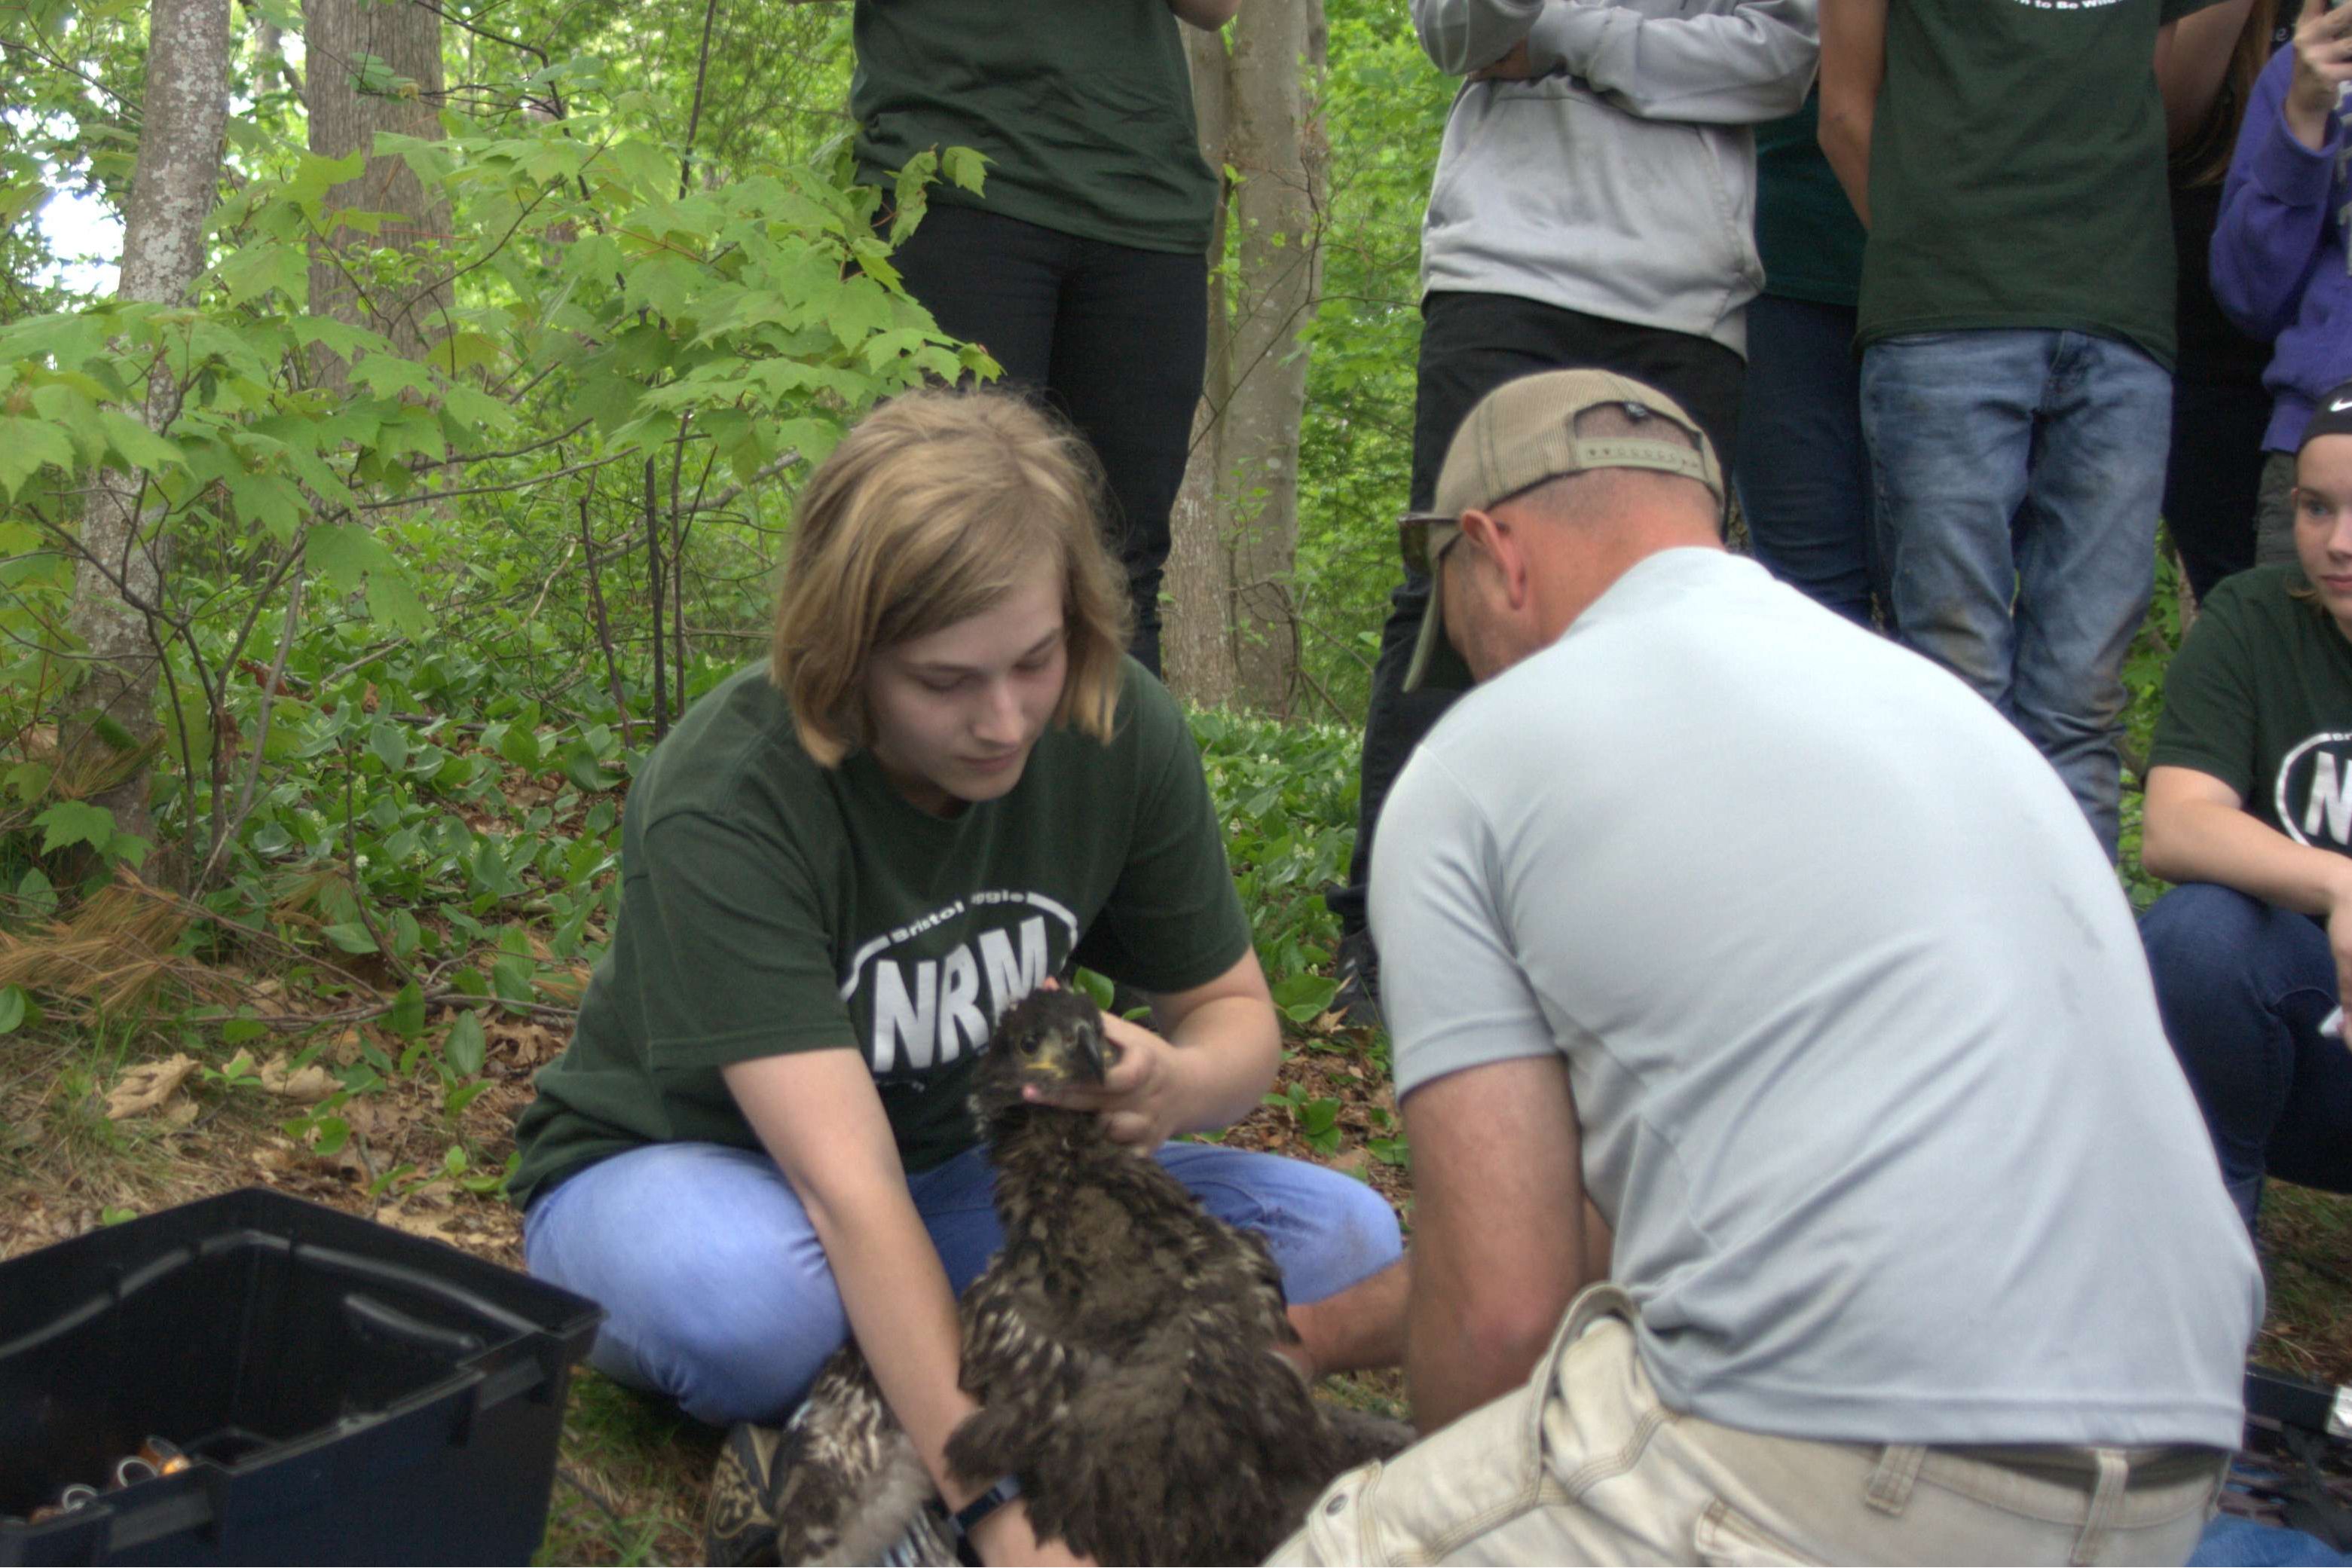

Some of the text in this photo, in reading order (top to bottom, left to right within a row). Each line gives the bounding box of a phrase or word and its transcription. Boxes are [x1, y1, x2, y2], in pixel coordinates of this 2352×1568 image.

[2035, 0, 2052, 8] to
[2057, 0, 2079, 9] Be
[891, 889, 1025, 943] Bristol ggie
[873, 915, 1047, 1073] NRM
